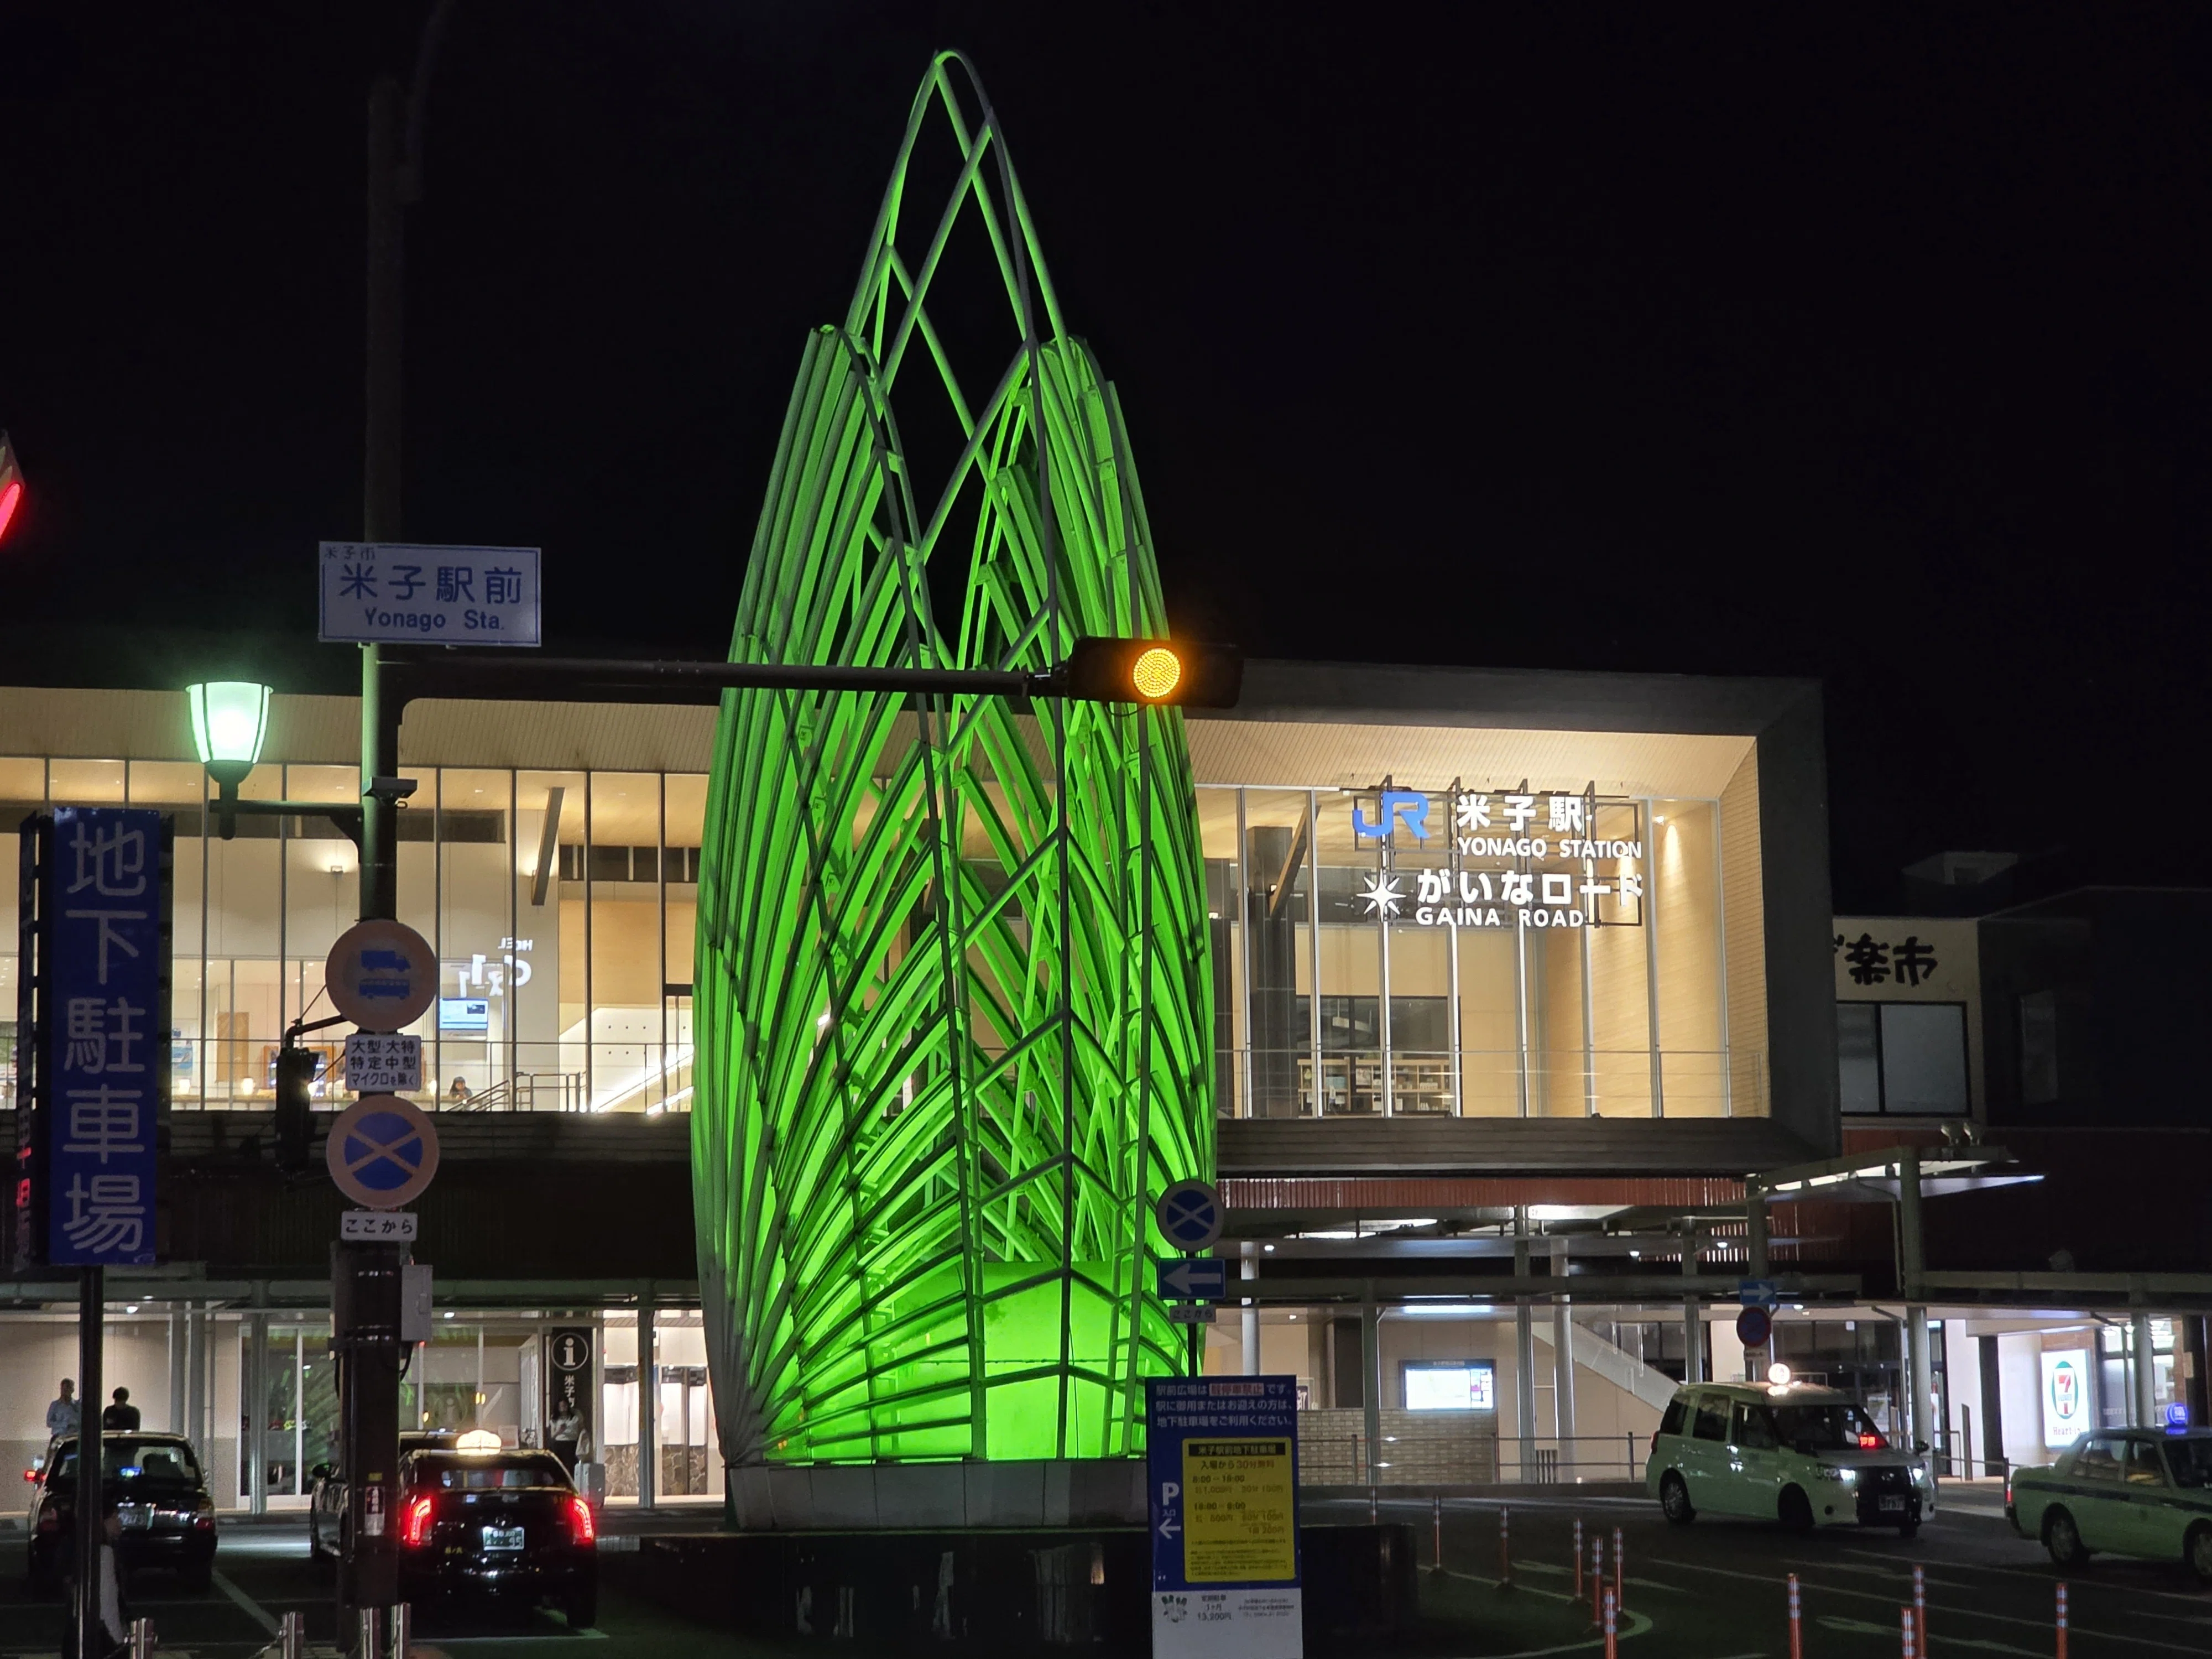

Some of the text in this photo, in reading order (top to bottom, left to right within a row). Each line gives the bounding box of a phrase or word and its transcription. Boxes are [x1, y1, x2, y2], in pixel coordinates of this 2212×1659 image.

[339, 563, 521, 604] 米子駅前
[364, 608, 504, 632] Yonago Sta.
[1352, 792, 1430, 838] JR
[1457, 794, 1582, 832] 米子駅
[1458, 837, 1641, 858] YONAGO STATION
[1417, 868, 1643, 906] がいなロード
[1416, 907, 1584, 927] GAINA ROAD
[63, 821, 147, 1254] 地下駐車場
[351, 1056, 416, 1070] 特定中型
[346, 1219, 413, 1234] ここから
[1173, 1308, 1213, 1319] ここから
[1162, 1482, 1180, 1506] P
